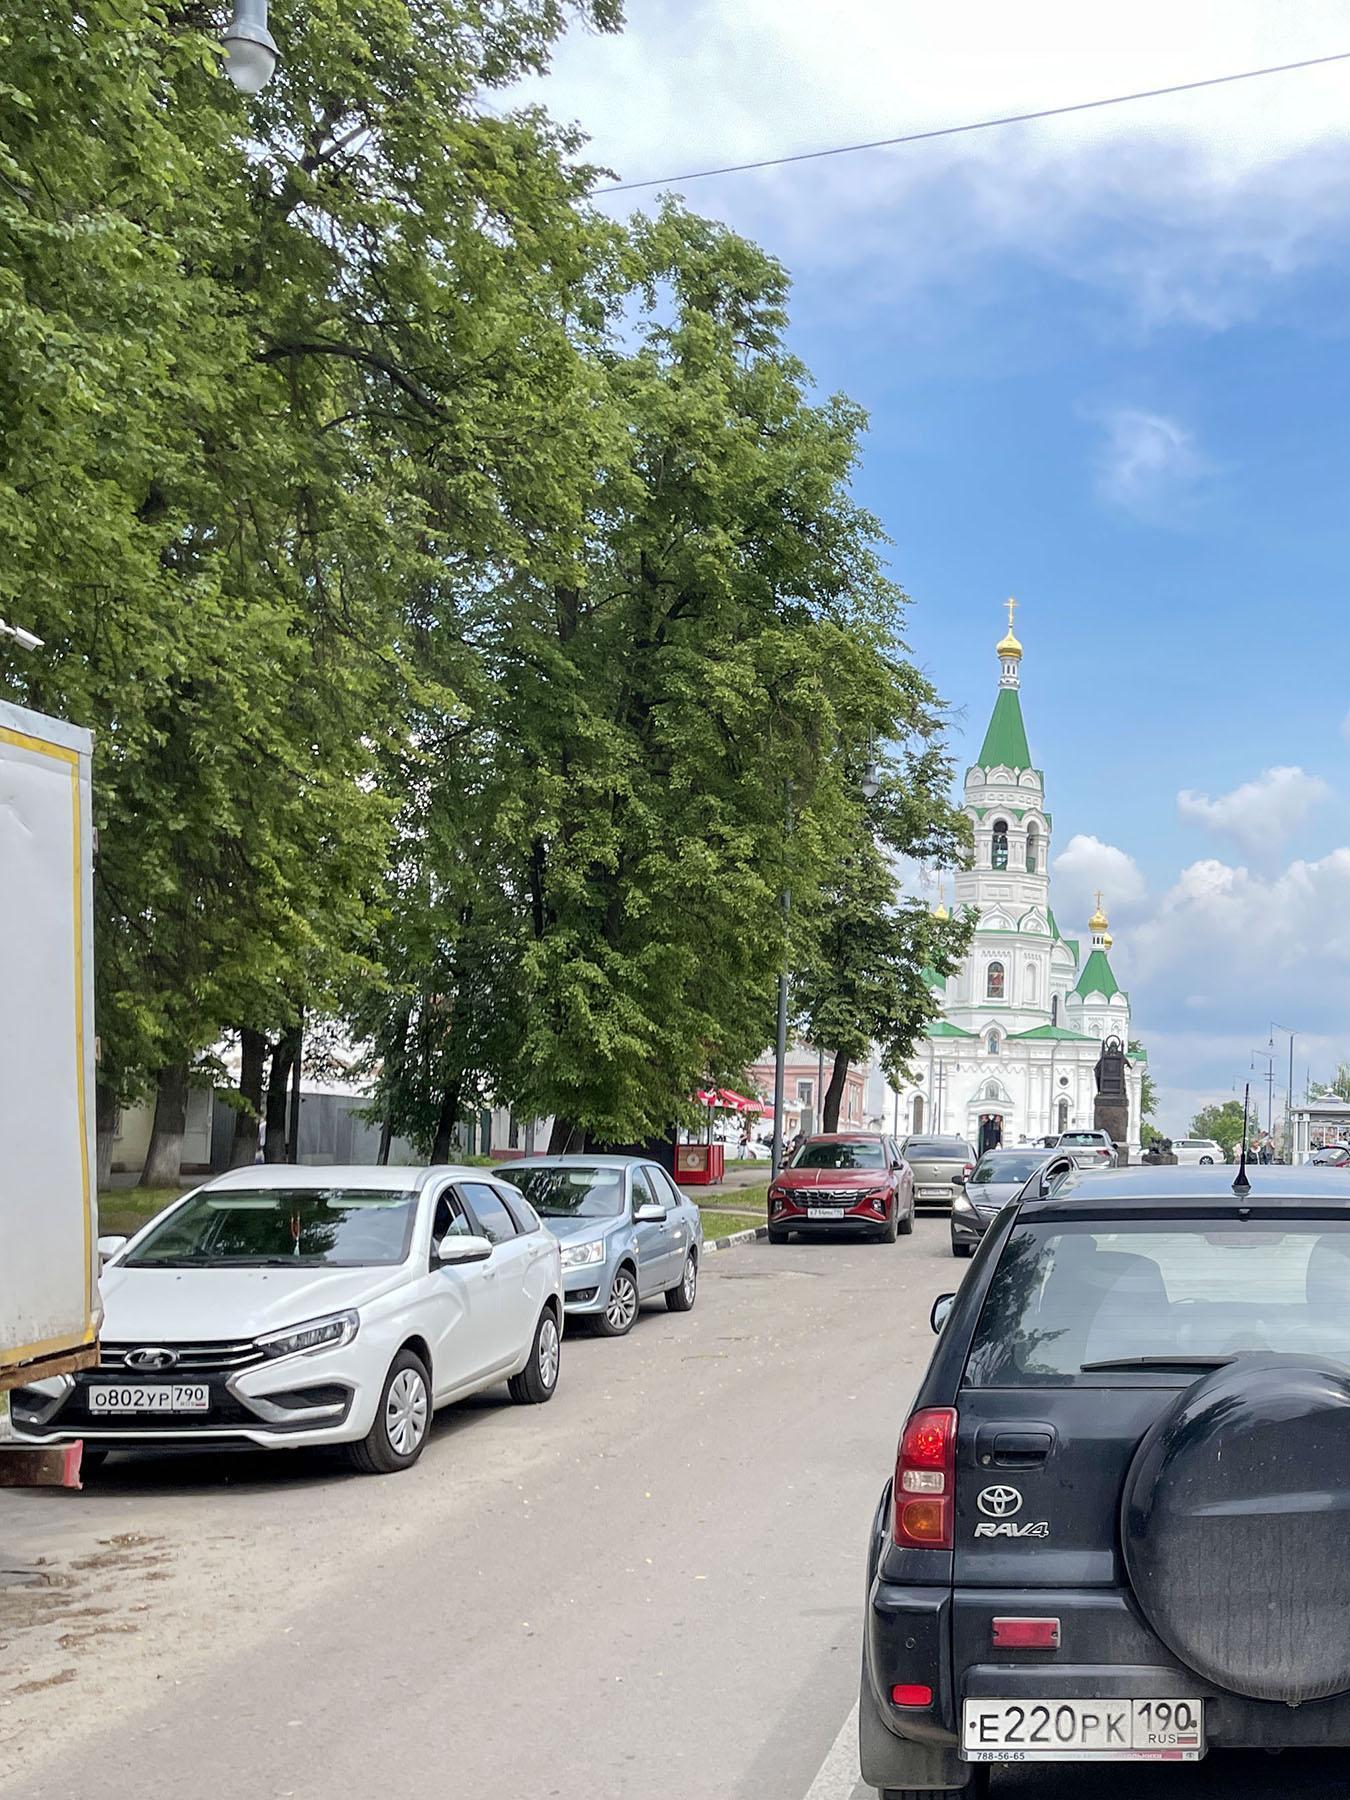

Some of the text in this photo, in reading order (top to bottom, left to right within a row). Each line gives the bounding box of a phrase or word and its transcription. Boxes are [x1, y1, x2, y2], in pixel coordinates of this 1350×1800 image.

[174, 1387, 204, 1401] 790
[974, 1522, 1050, 1538] RAV4
[1138, 1702, 1192, 1731] 190
[1149, 1733, 1176, 1744] RUS
[976, 1752, 1025, 1760] 788-56-65
